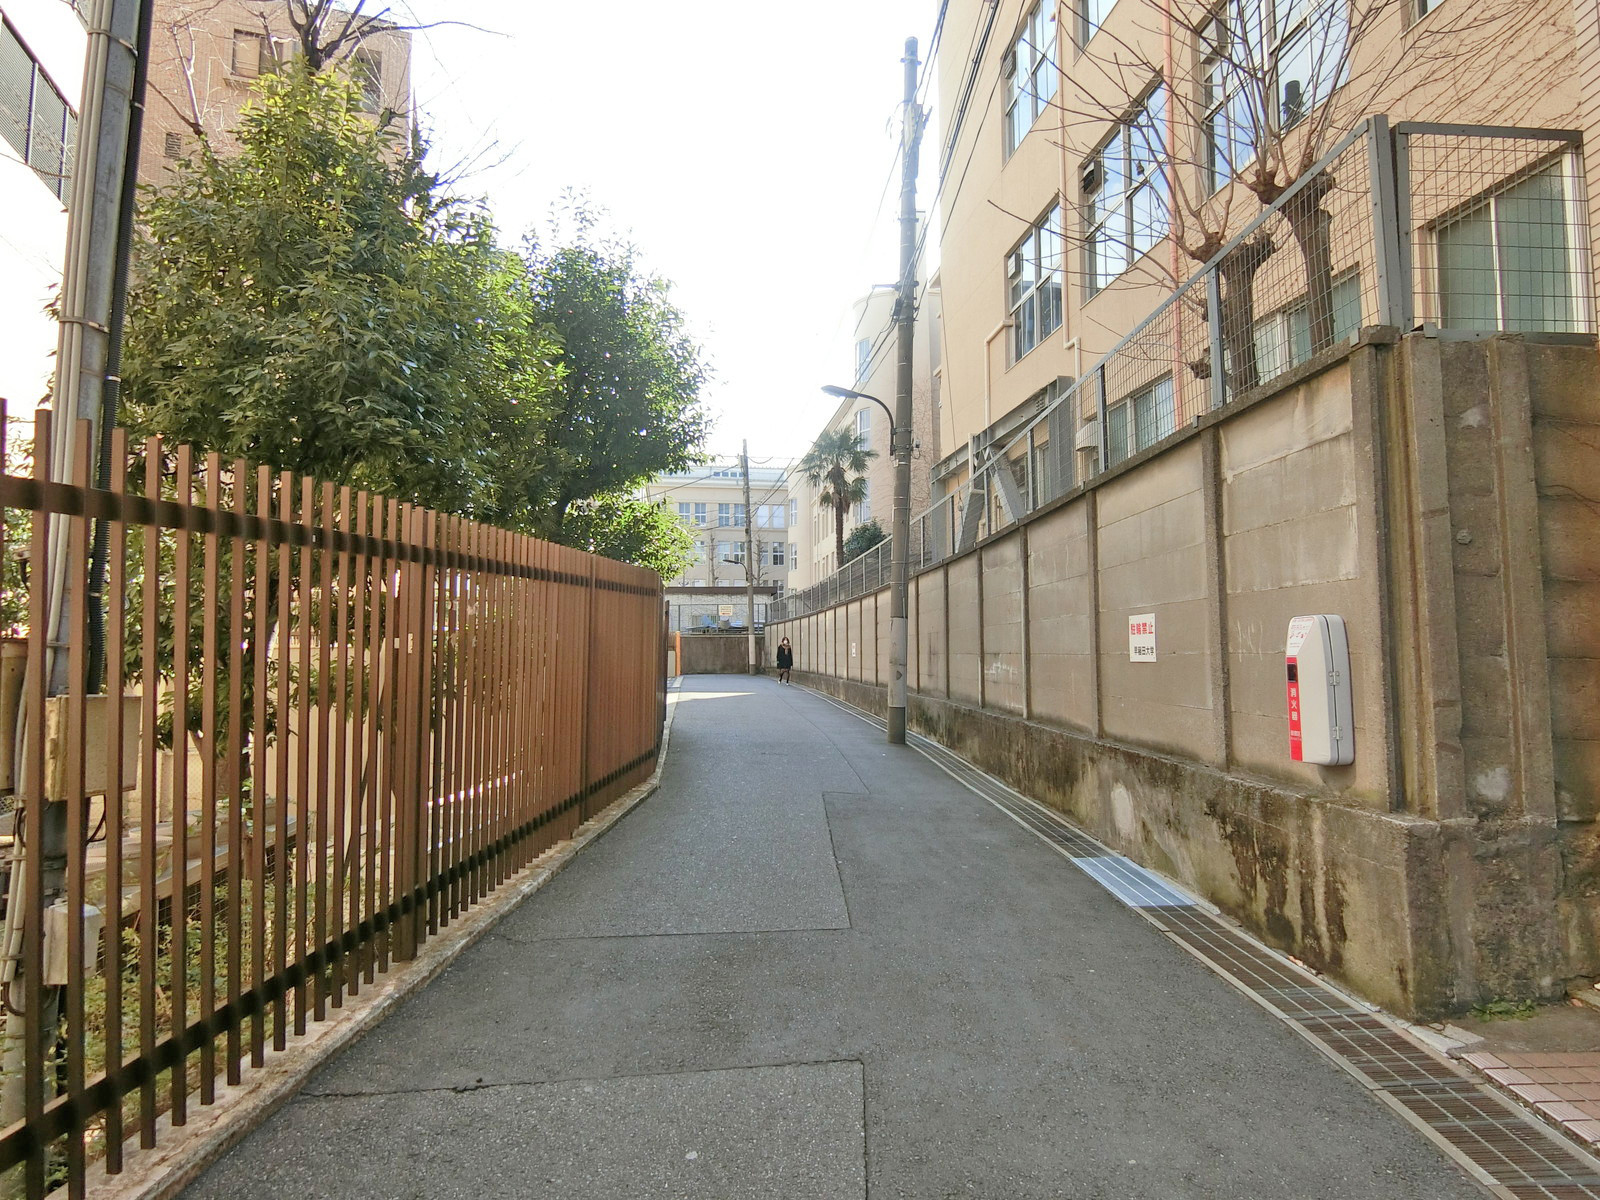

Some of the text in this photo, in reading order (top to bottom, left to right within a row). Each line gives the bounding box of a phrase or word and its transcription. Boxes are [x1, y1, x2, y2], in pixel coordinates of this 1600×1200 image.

[1130, 622, 1153, 635] 駐輪禁止
[1290, 688, 1298, 720] 消火器
